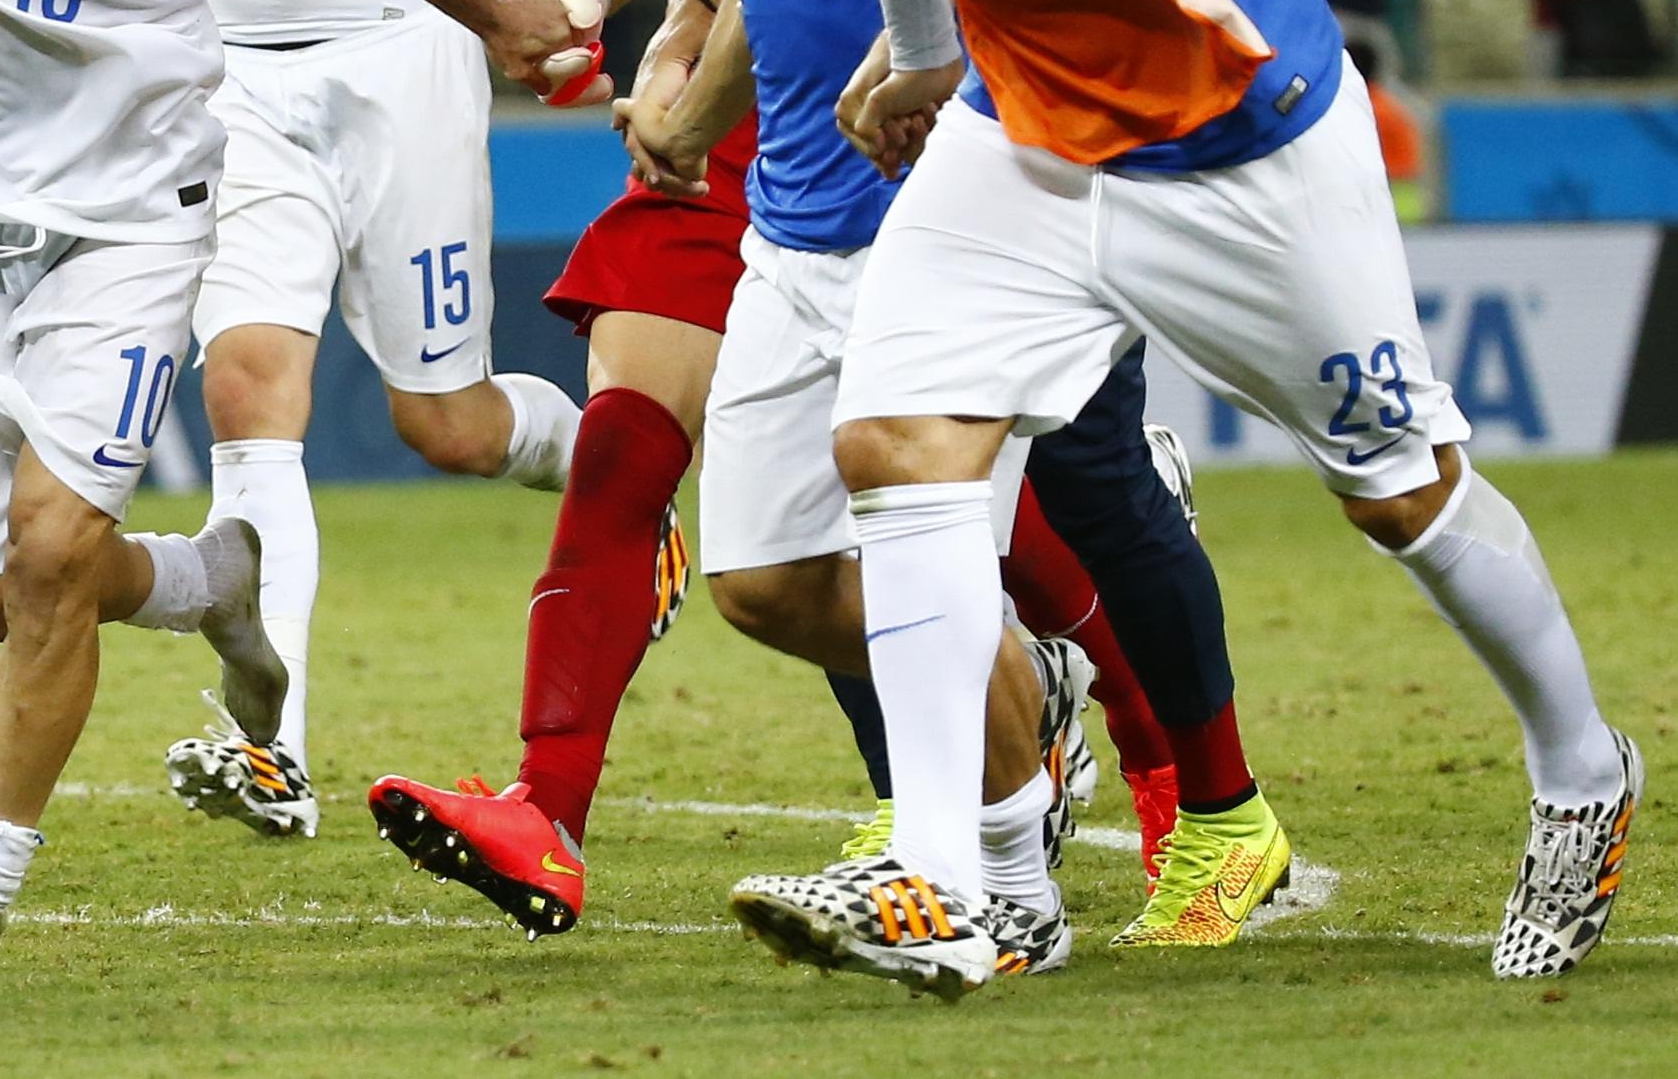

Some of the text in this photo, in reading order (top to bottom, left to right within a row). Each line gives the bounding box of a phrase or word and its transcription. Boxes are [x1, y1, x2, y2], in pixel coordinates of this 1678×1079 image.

[411, 241, 471, 329] 15
[115, 345, 174, 448] 10
[1320, 340, 1413, 436] 23
